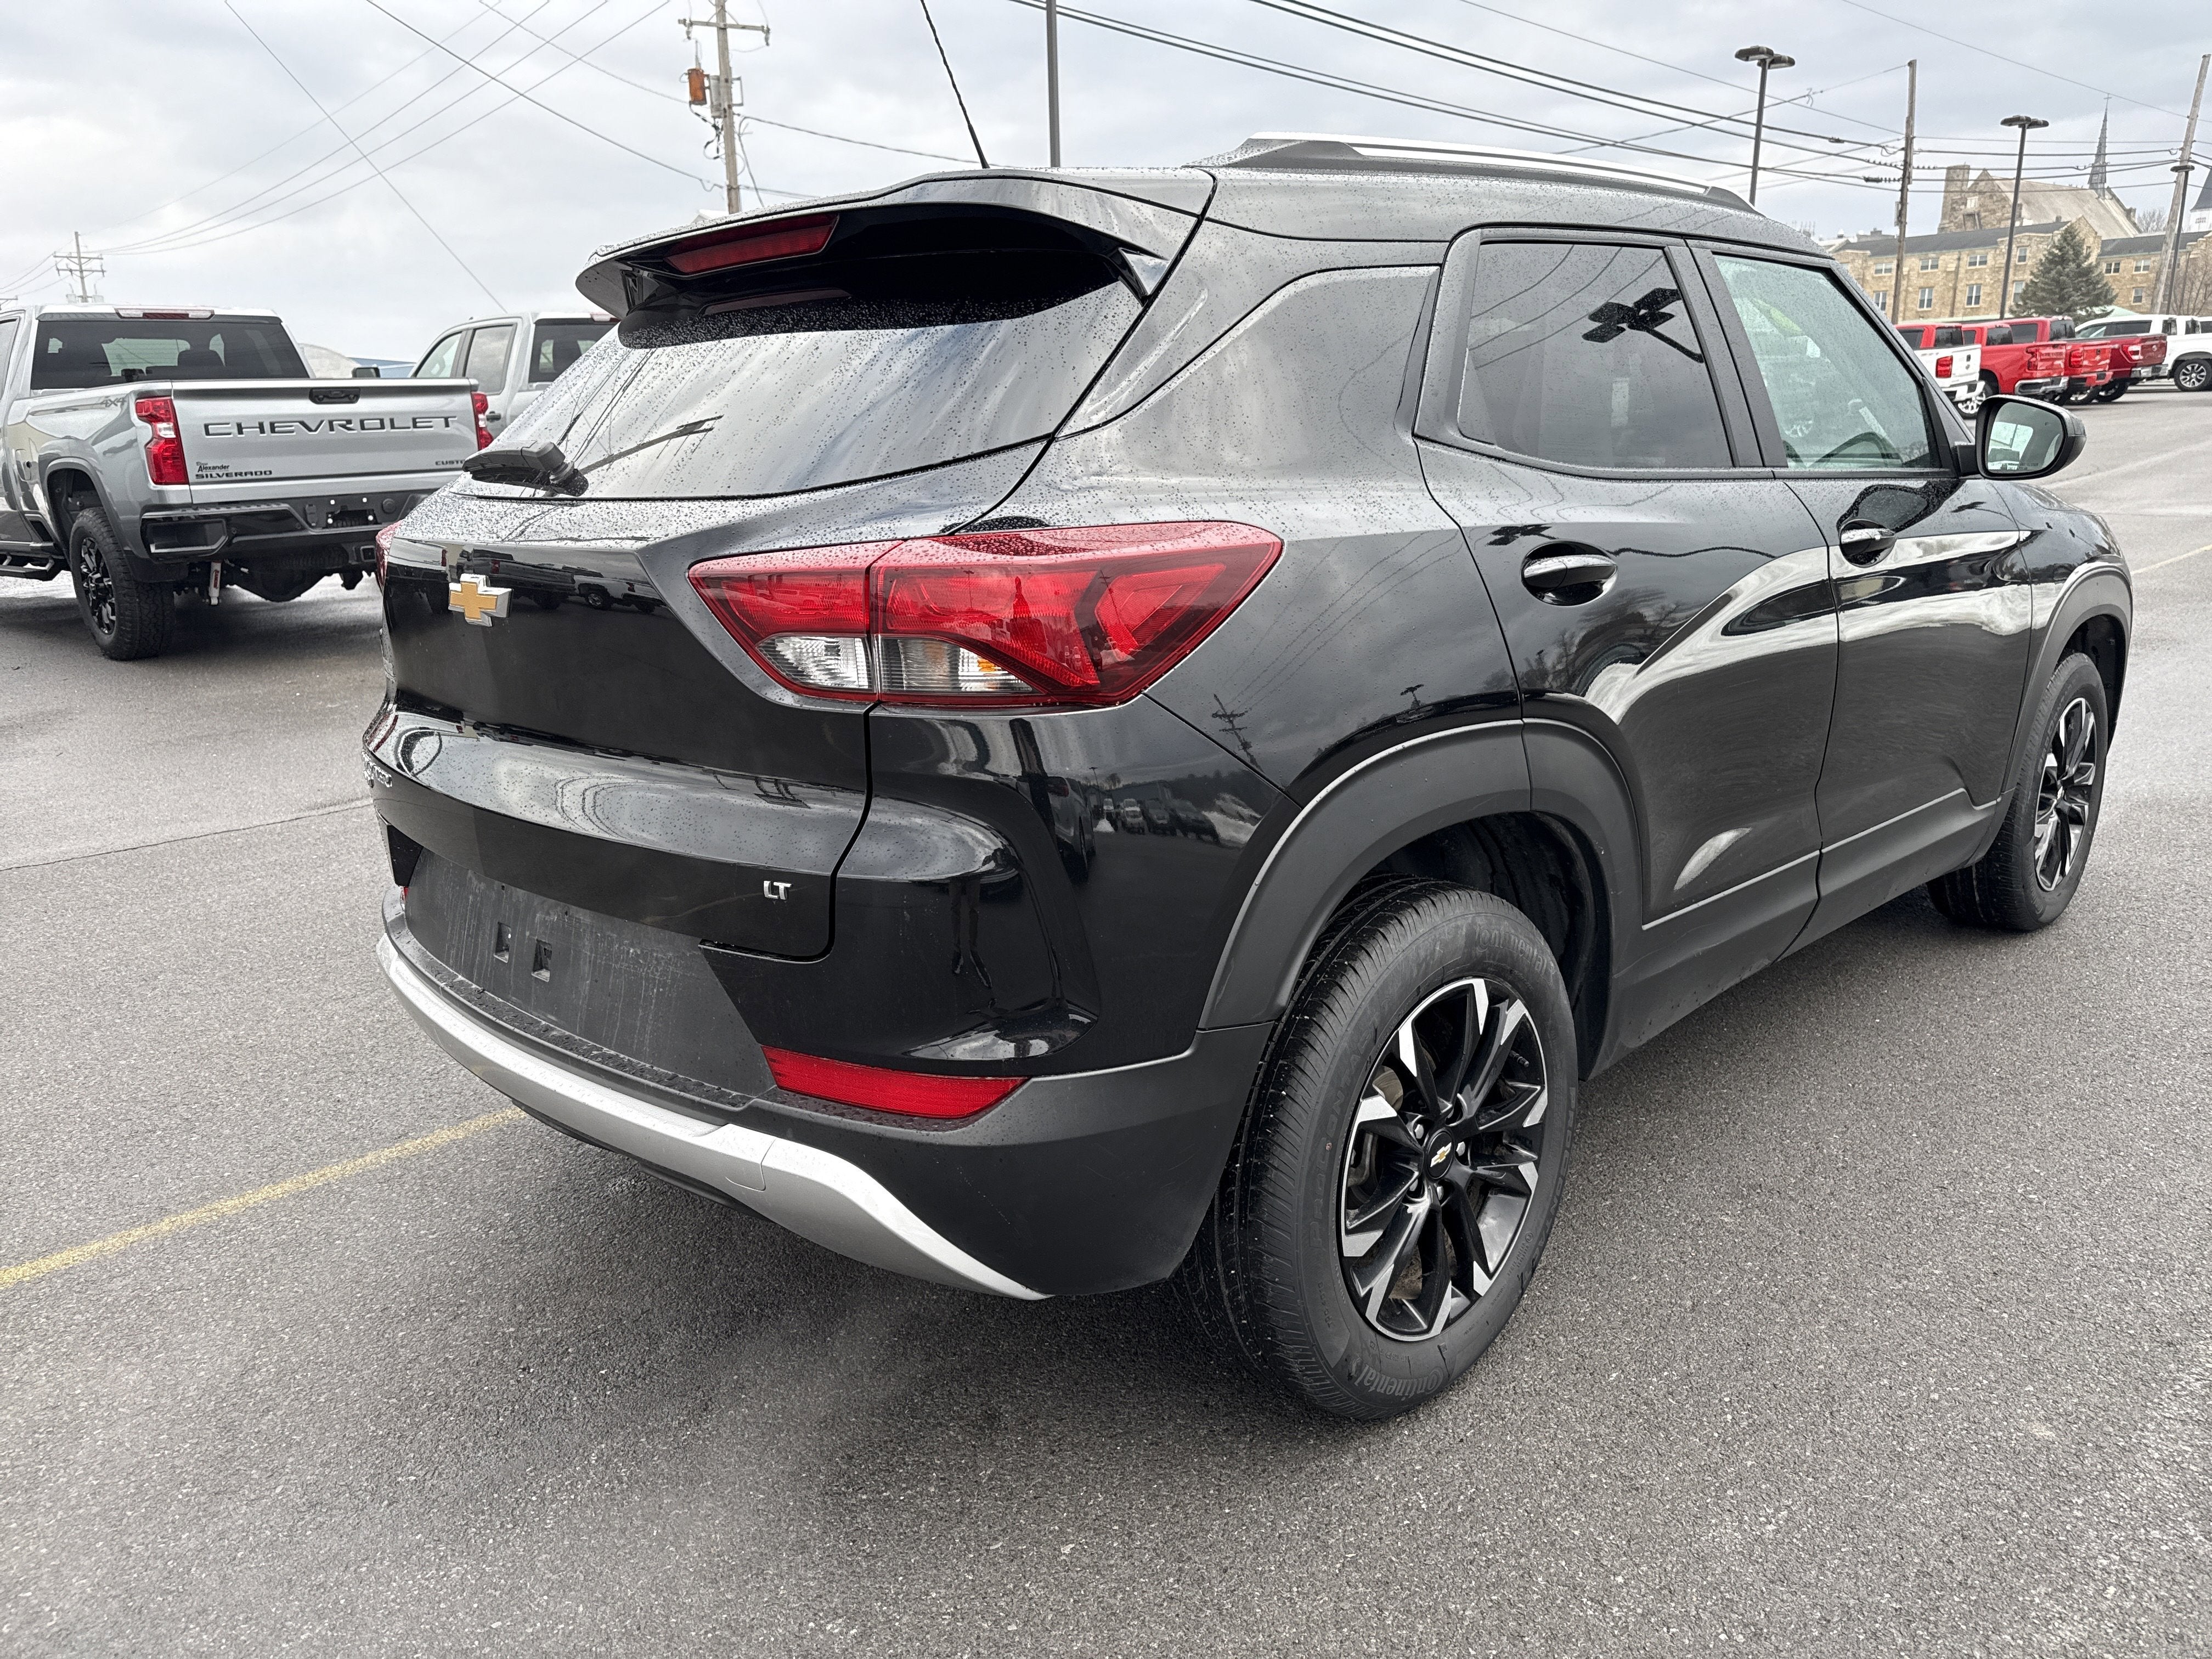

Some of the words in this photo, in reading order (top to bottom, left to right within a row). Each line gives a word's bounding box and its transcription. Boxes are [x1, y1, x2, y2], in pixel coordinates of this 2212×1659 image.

[204, 416, 457, 437] CHEVROLET
[195, 470, 272, 479] SILVERADO
[198, 464, 230, 472] Alexander
[763, 880, 792, 900] LT
[1475, 921, 1548, 977] Continental
[1354, 1363, 1444, 1401] Continental
